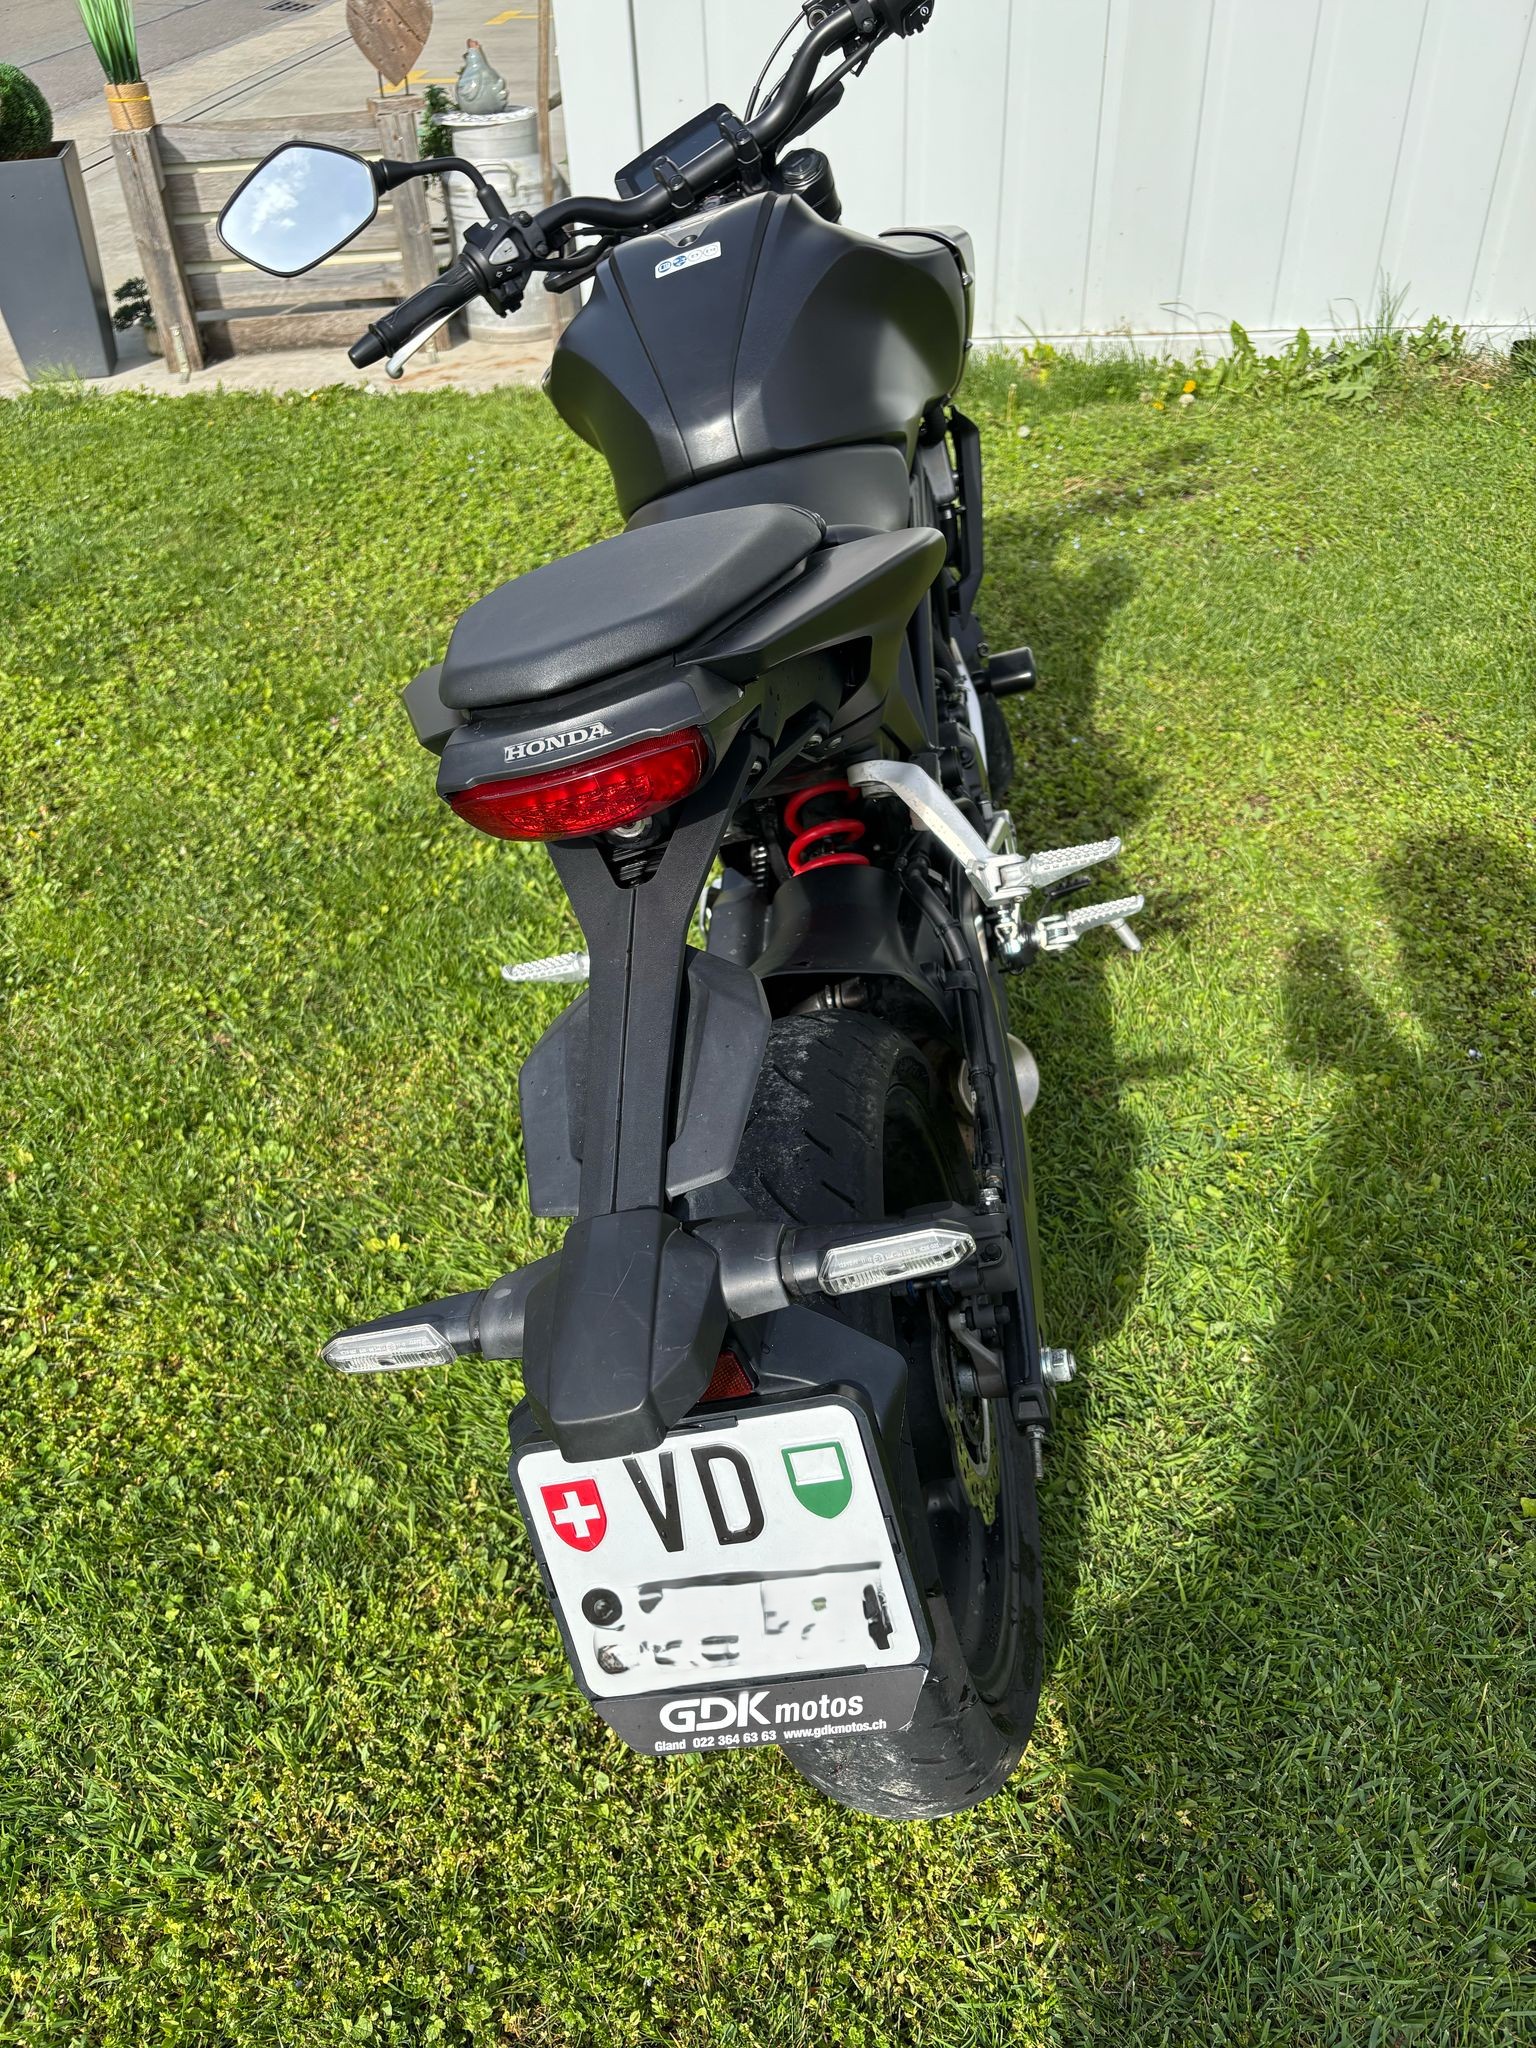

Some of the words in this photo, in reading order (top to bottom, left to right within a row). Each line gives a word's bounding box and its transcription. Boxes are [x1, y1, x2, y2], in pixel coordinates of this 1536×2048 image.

[504, 721, 612, 763] HONDA
[622, 1442, 766, 1553] VD
[659, 1690, 771, 1733] GDK
[775, 1694, 864, 1723] motos
[654, 1738, 686, 1752] Gland
[692, 1736, 715, 1749] 022
[718, 1733, 740, 1747] 364
[743, 1731, 758, 1744] 63
[761, 1730, 777, 1742] 63
[783, 1718, 887, 1740] www.gdkmotos.ch
